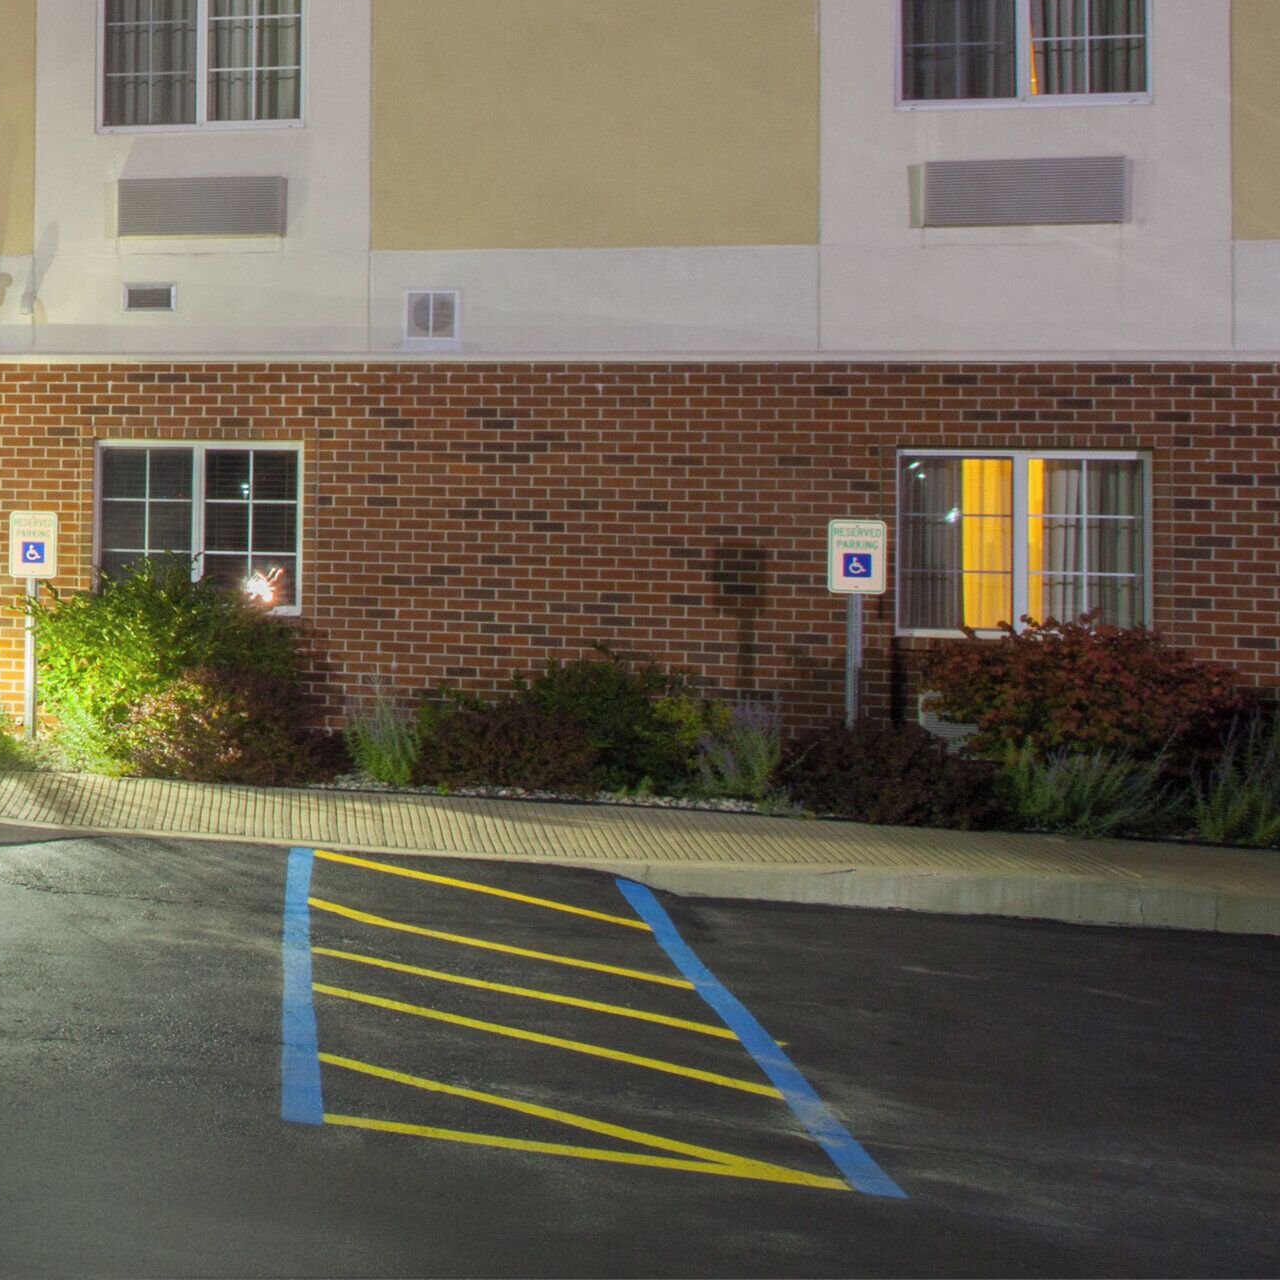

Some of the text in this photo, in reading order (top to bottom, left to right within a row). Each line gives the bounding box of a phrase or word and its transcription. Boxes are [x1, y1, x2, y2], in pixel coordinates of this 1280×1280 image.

[13, 518, 53, 527] RESERVED
[16, 529, 51, 538] PARKING
[833, 527, 882, 538] RESERVED
[836, 540, 879, 550] PARKING
